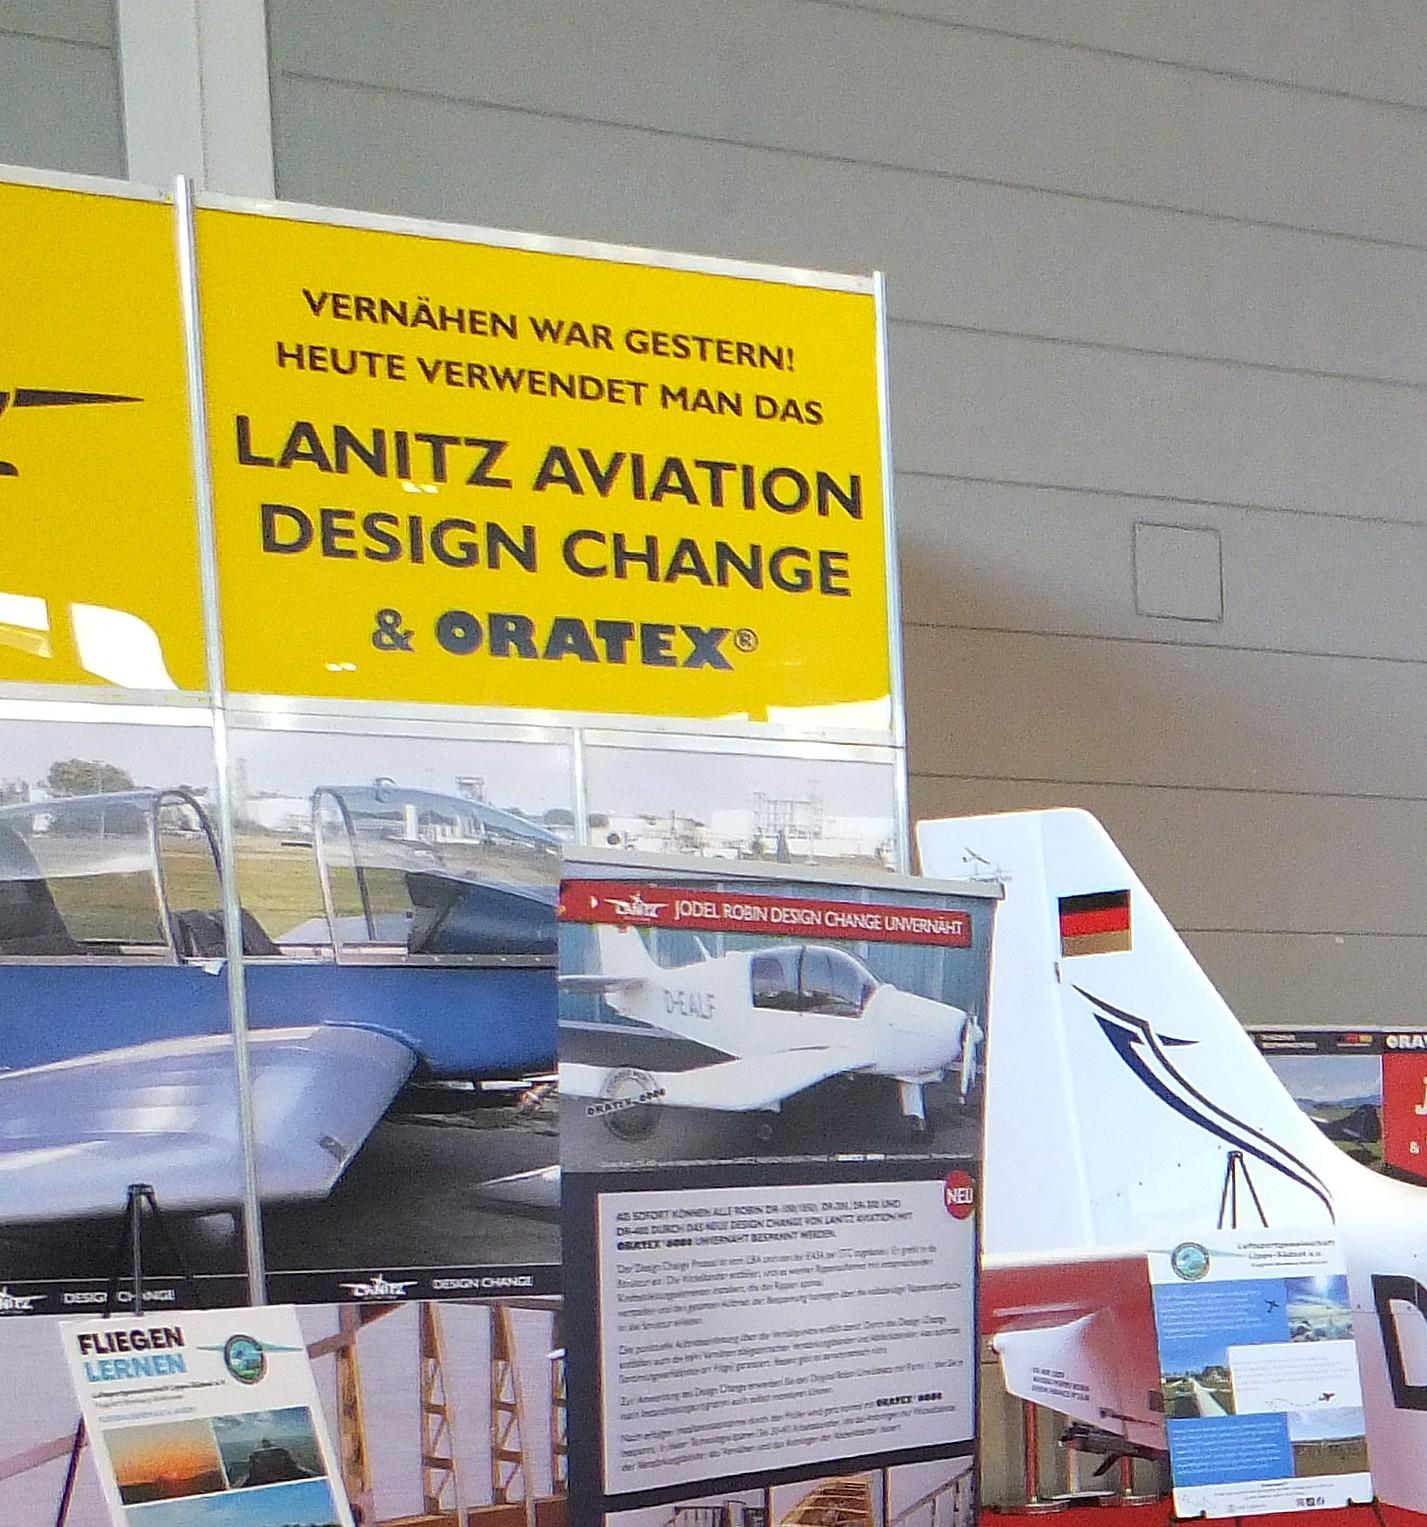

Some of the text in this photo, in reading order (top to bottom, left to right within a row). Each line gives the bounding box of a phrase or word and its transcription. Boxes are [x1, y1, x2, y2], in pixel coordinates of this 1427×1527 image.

[302, 287, 796, 373] VERNÄHEN WAR GESTERN!
[276, 340, 824, 427] HEUTE VERWENDET MAN DAS
[235, 414, 864, 522] LANITZ AVIATION
[261, 503, 852, 598] DESIGN CHANGE
[371, 607, 415, 653] &
[674, 899, 720, 920] JODEL
[724, 903, 768, 921] ROBIN
[771, 906, 822, 926] DESIGN
[824, 911, 882, 931] CHANGE
[885, 914, 964, 936] UNVERNÄHT
[1409, 1139, 1420, 1154] &
[946, 1187, 974, 1206] NEU
[63, 1291, 109, 1304] DESIG
[432, 1278, 480, 1289] DESIGN
[481, 1275, 534, 1288] CHANGE
[76, 1325, 186, 1356] FLIEGEN
[82, 1352, 188, 1383] LERNEN
